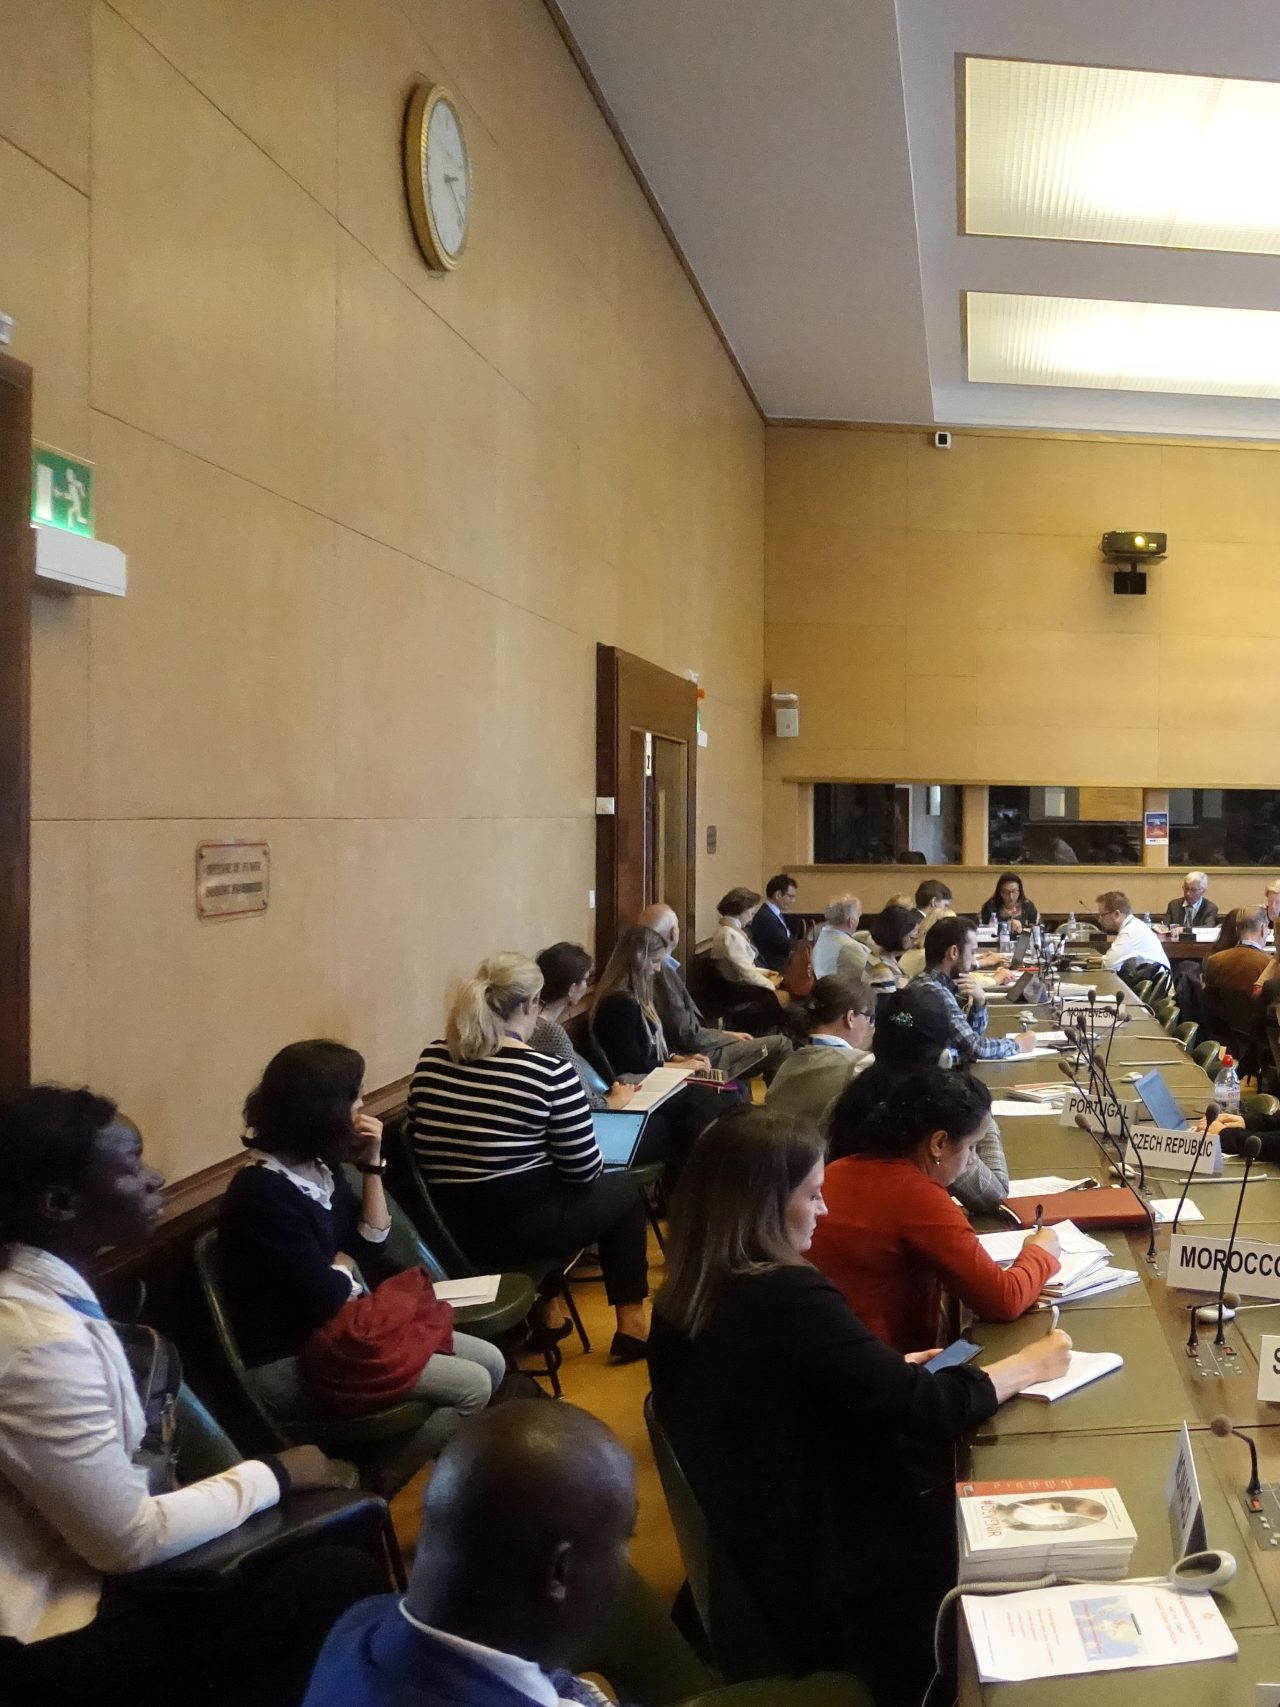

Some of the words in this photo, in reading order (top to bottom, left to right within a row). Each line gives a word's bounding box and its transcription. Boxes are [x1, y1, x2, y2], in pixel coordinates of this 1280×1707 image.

[1067, 1007, 1118, 1019] MONTENEGR
[1069, 1098, 1129, 1120] PORTUGAL
[1132, 1133, 1163, 1152] CZECH
[1165, 1136, 1213, 1158] REPUBLIC
